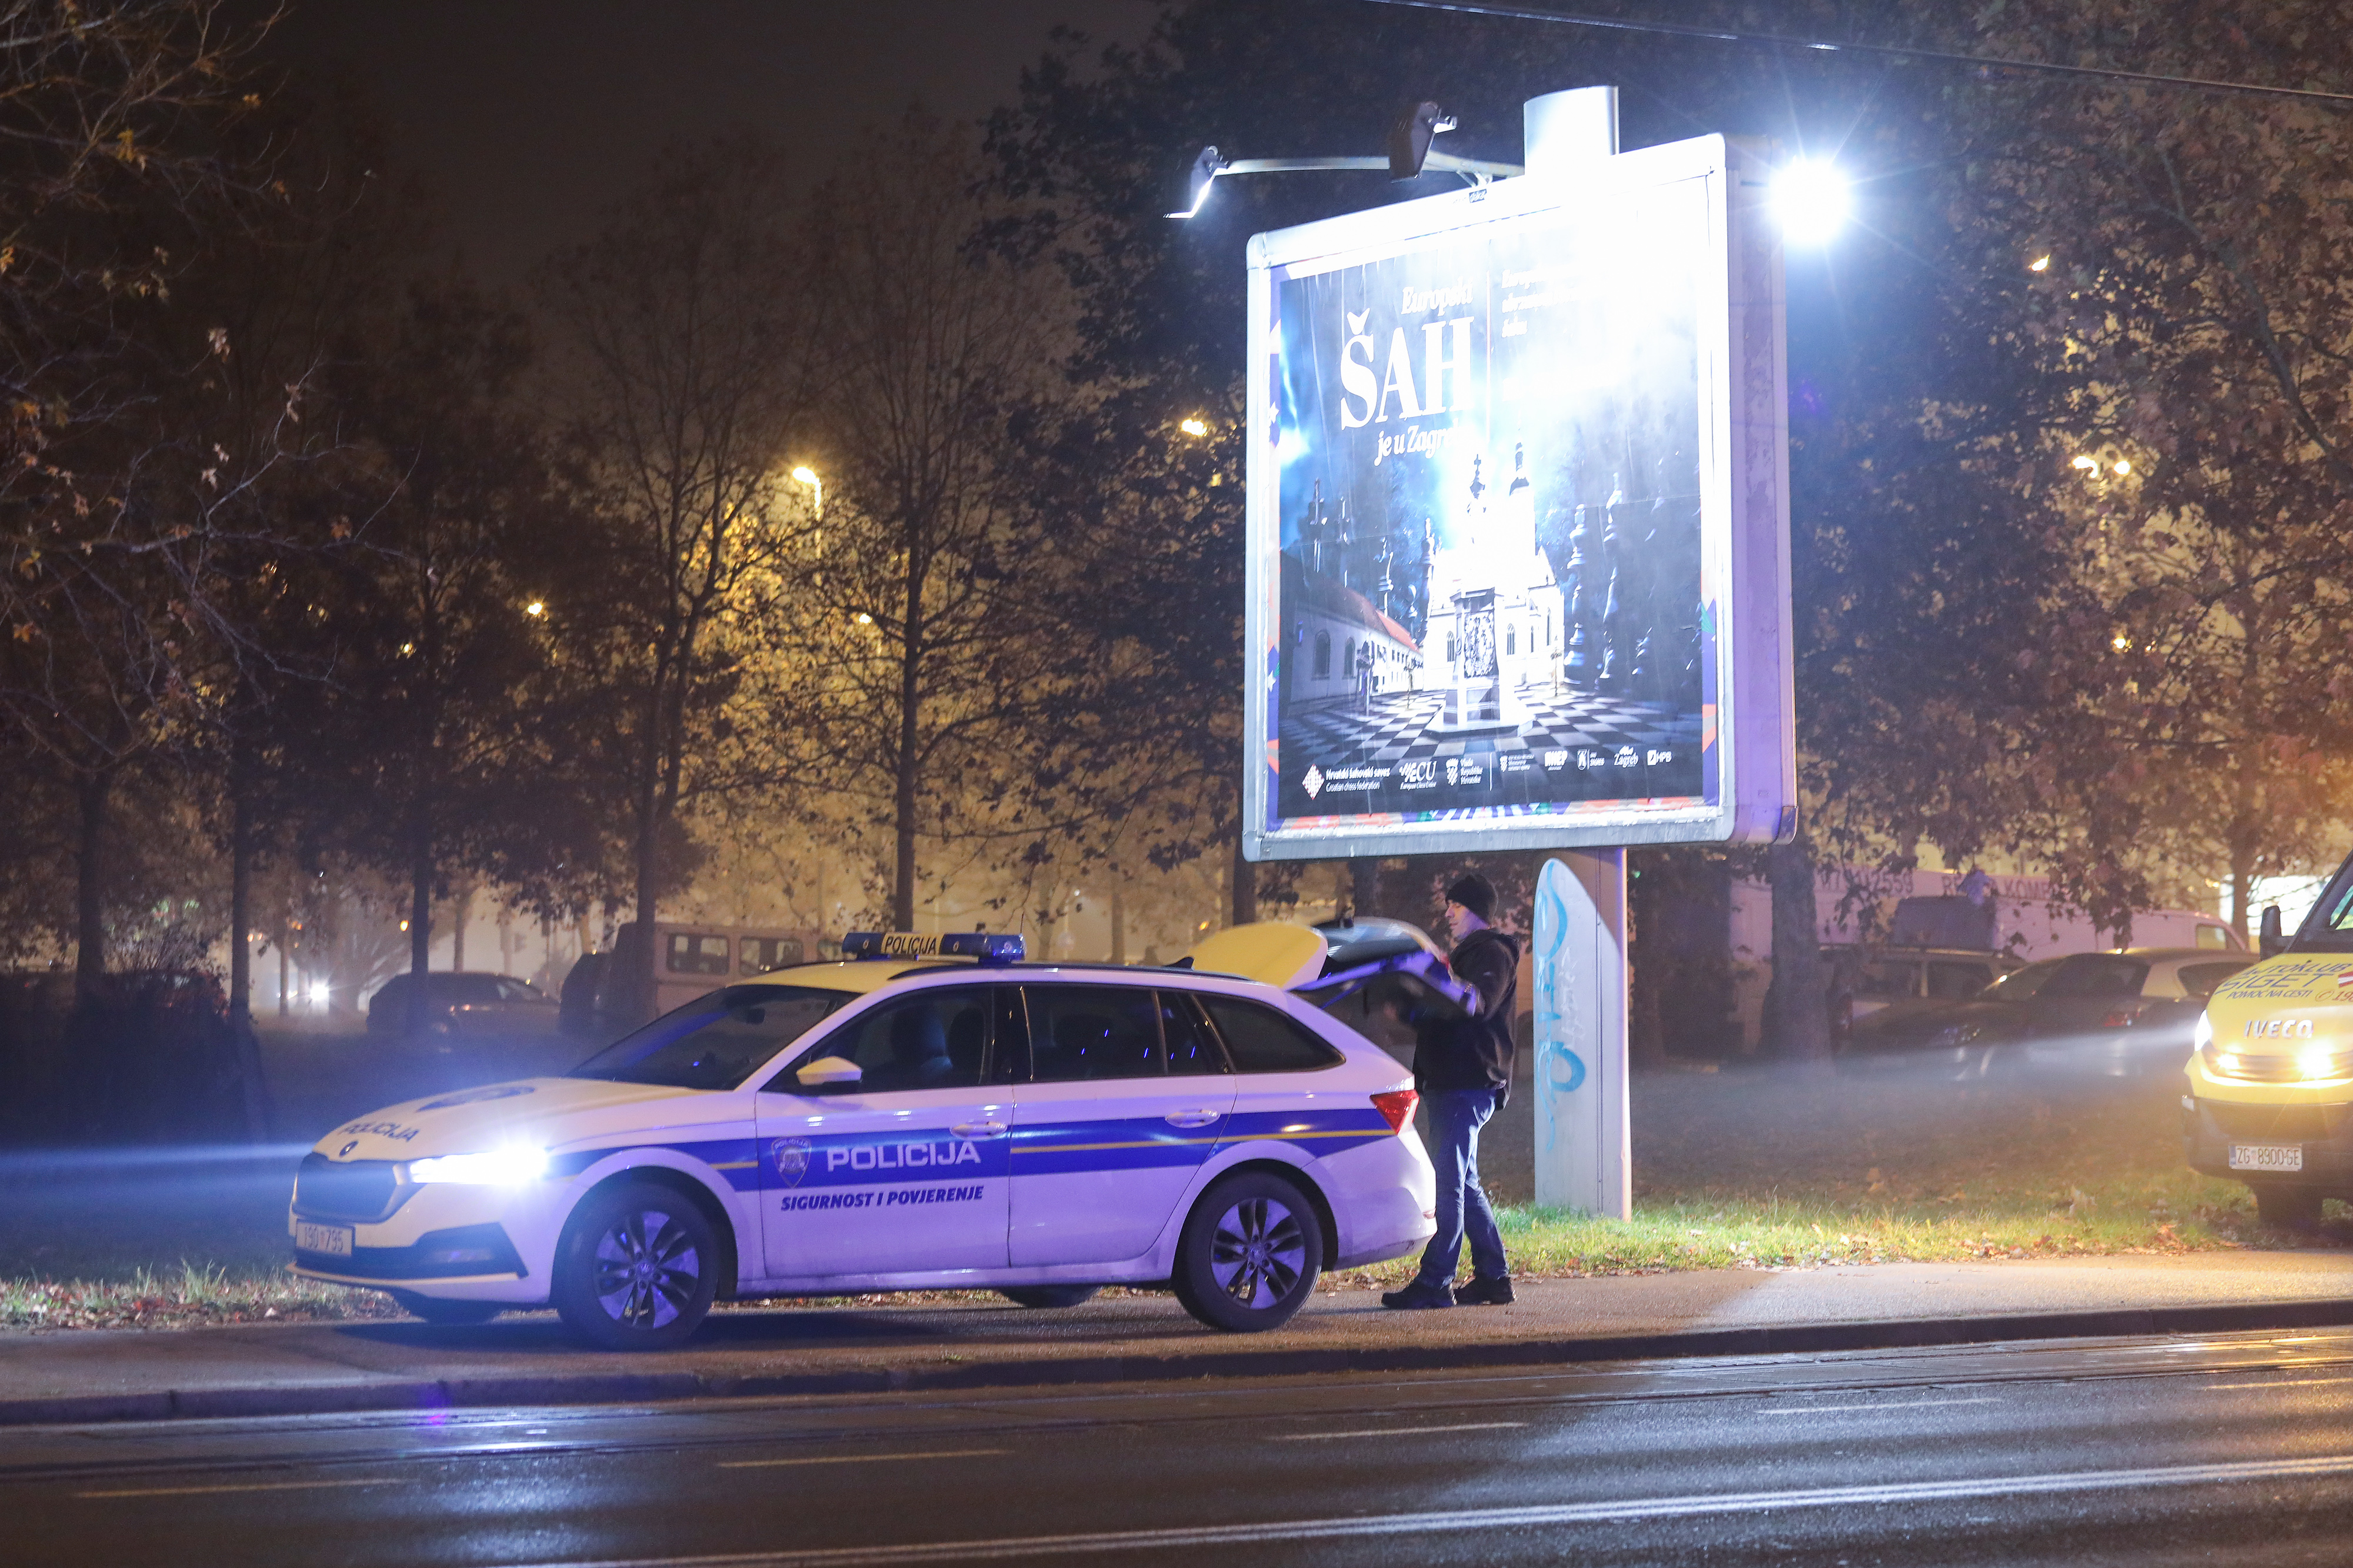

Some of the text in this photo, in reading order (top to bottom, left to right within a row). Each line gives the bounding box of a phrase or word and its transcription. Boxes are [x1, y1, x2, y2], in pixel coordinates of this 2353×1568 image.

[1401, 276, 1474, 315] Europski
[1341, 308, 1475, 430] ŠAH
[1374, 431, 1392, 466] je
[1394, 434, 1405, 454] u
[1614, 752, 1639, 768] Zagreb
[1326, 766, 1391, 780] Hrvatski šahovski savez
[1460, 766, 1483, 777] Republike
[1460, 775, 1482, 785] Hrvatske
[1326, 780, 1381, 792] Croatian chess federation
[884, 936, 937, 955] POLICIJA
[2215, 973, 2334, 995] SIGET
[2266, 990, 2282, 998] NA
[2284, 990, 2314, 998] CESTI
[2243, 1019, 2313, 1039] IVECO
[827, 1140, 982, 1172] POLICIJA
[2237, 1147, 2250, 1164] ZG
[781, 1185, 985, 1212] SIGURNOST I POVJERENJE
